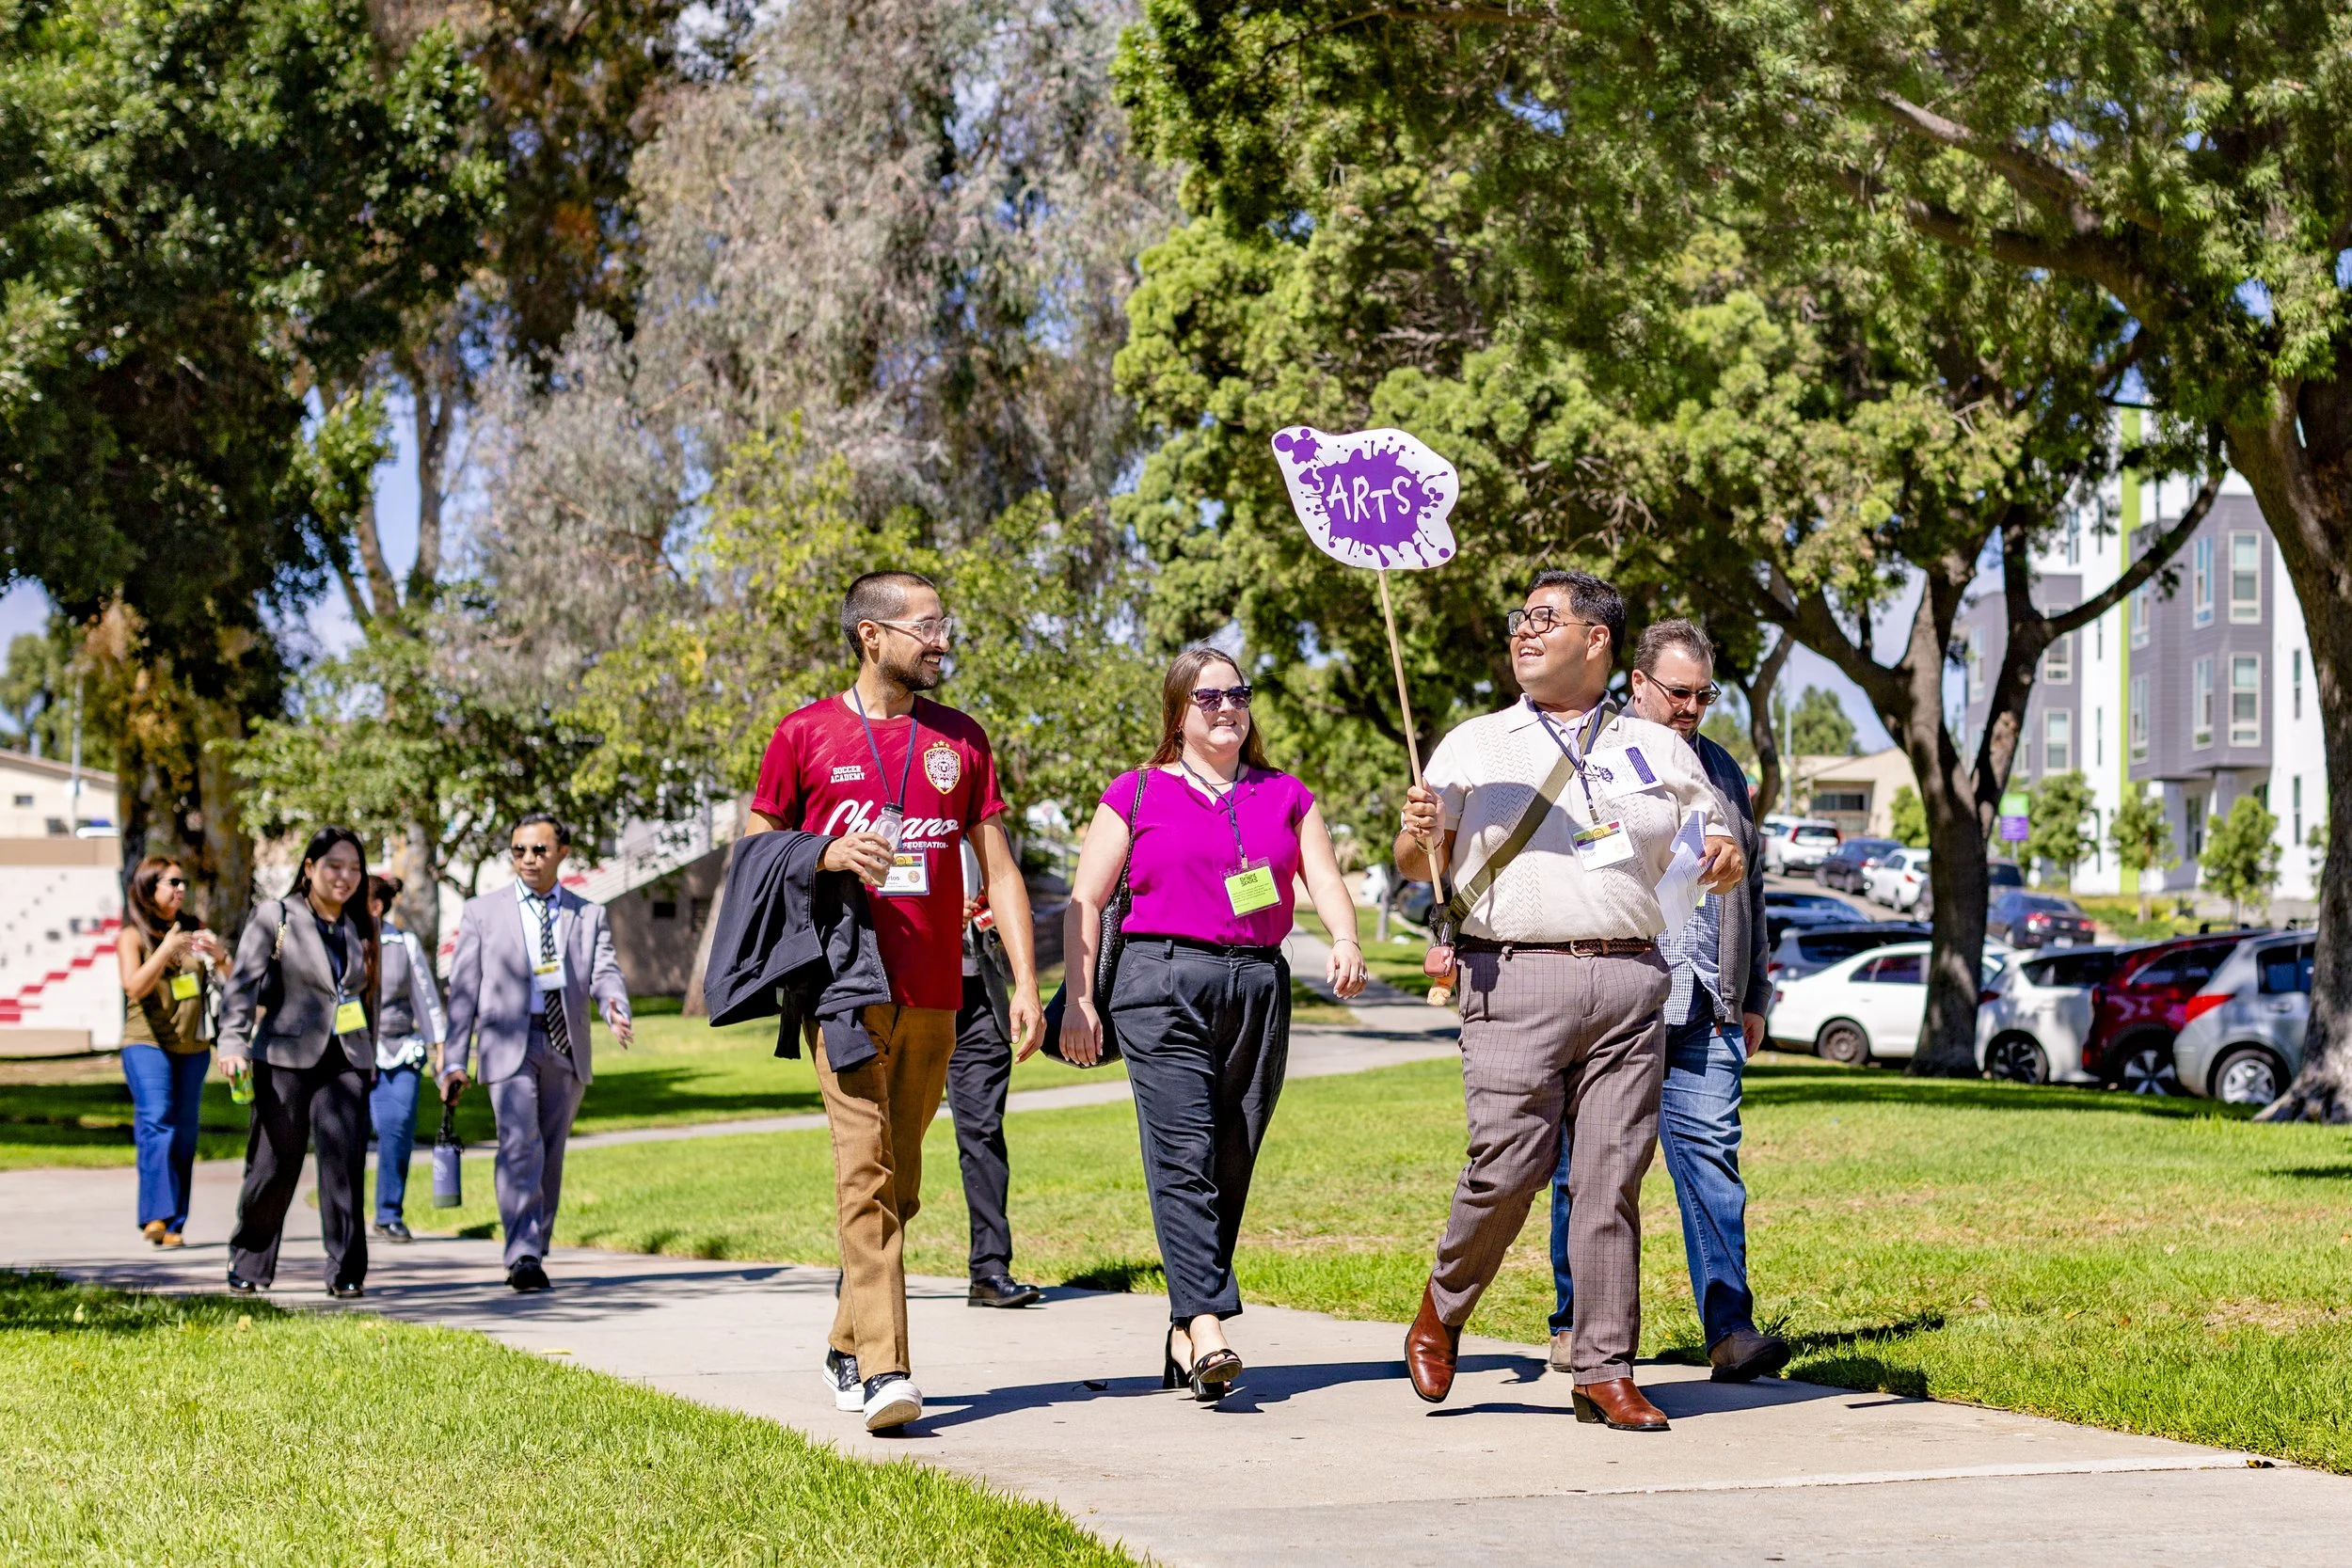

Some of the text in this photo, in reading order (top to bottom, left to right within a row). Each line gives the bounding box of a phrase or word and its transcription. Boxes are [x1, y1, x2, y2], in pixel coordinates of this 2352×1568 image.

[1326, 474, 1412, 524] ARTS
[830, 772, 865, 784] ACADEMY
[833, 765, 862, 774] SOCCER
[822, 800, 959, 840] Chano
